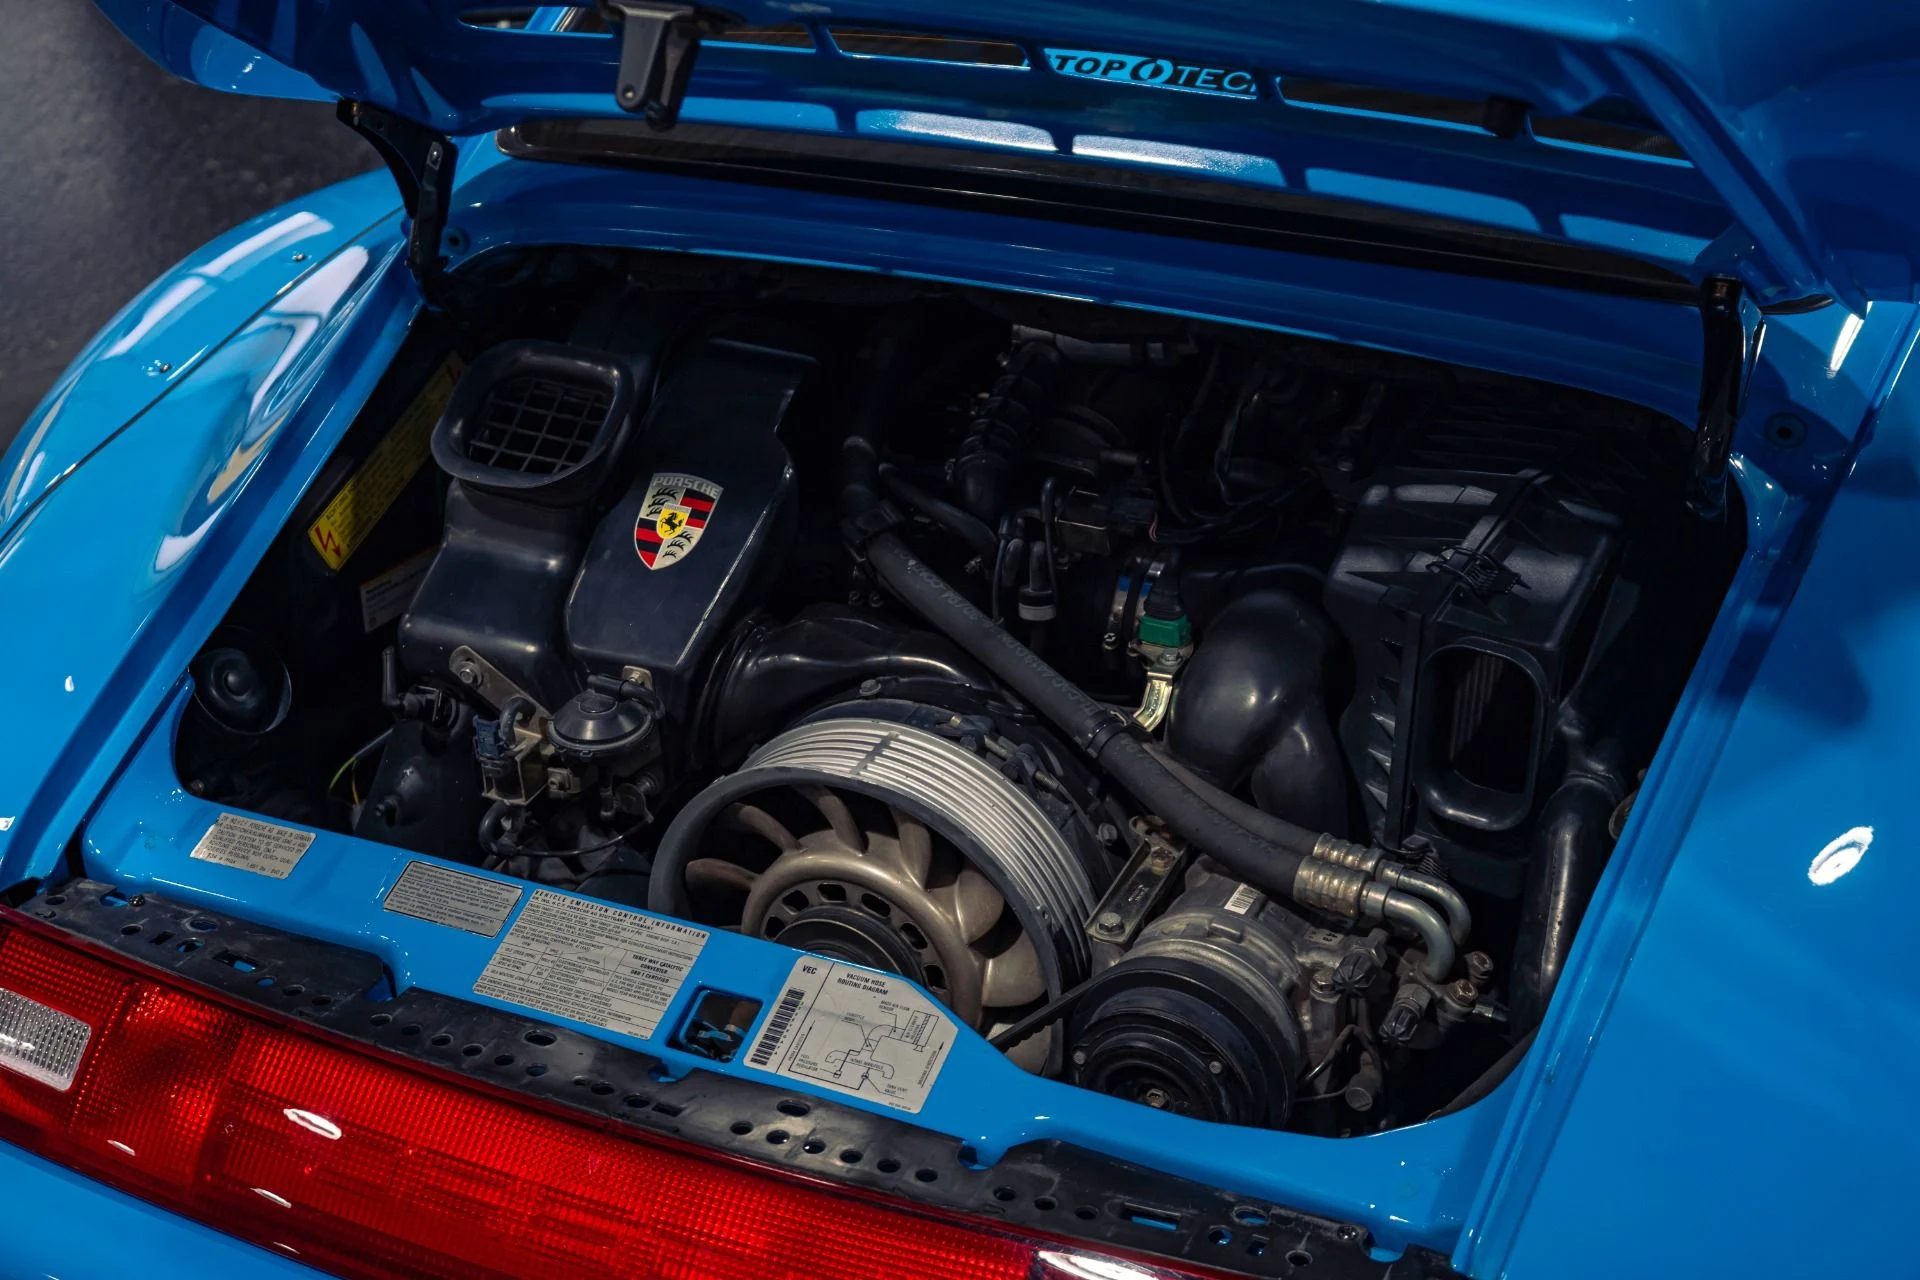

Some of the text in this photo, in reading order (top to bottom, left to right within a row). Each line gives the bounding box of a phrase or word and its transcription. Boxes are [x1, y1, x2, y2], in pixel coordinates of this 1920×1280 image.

[653, 476, 719, 498] PORSCHE
[534, 890, 567, 902] VEHICLE
[569, 899, 609, 913] EMISSION
[612, 910, 648, 923] CONTROL
[650, 920, 706, 938] INFORMATION
[631, 954, 648, 962] THREE
[658, 961, 684, 972] CATALYTIC
[639, 963, 668, 974] CONVERTER
[801, 965, 818, 975] VEC
[645, 973, 670, 983] CERTIFIED
[837, 977, 889, 995] ROUTING DIAGRAM
[845, 972, 886, 988] VACUUM HOSE
